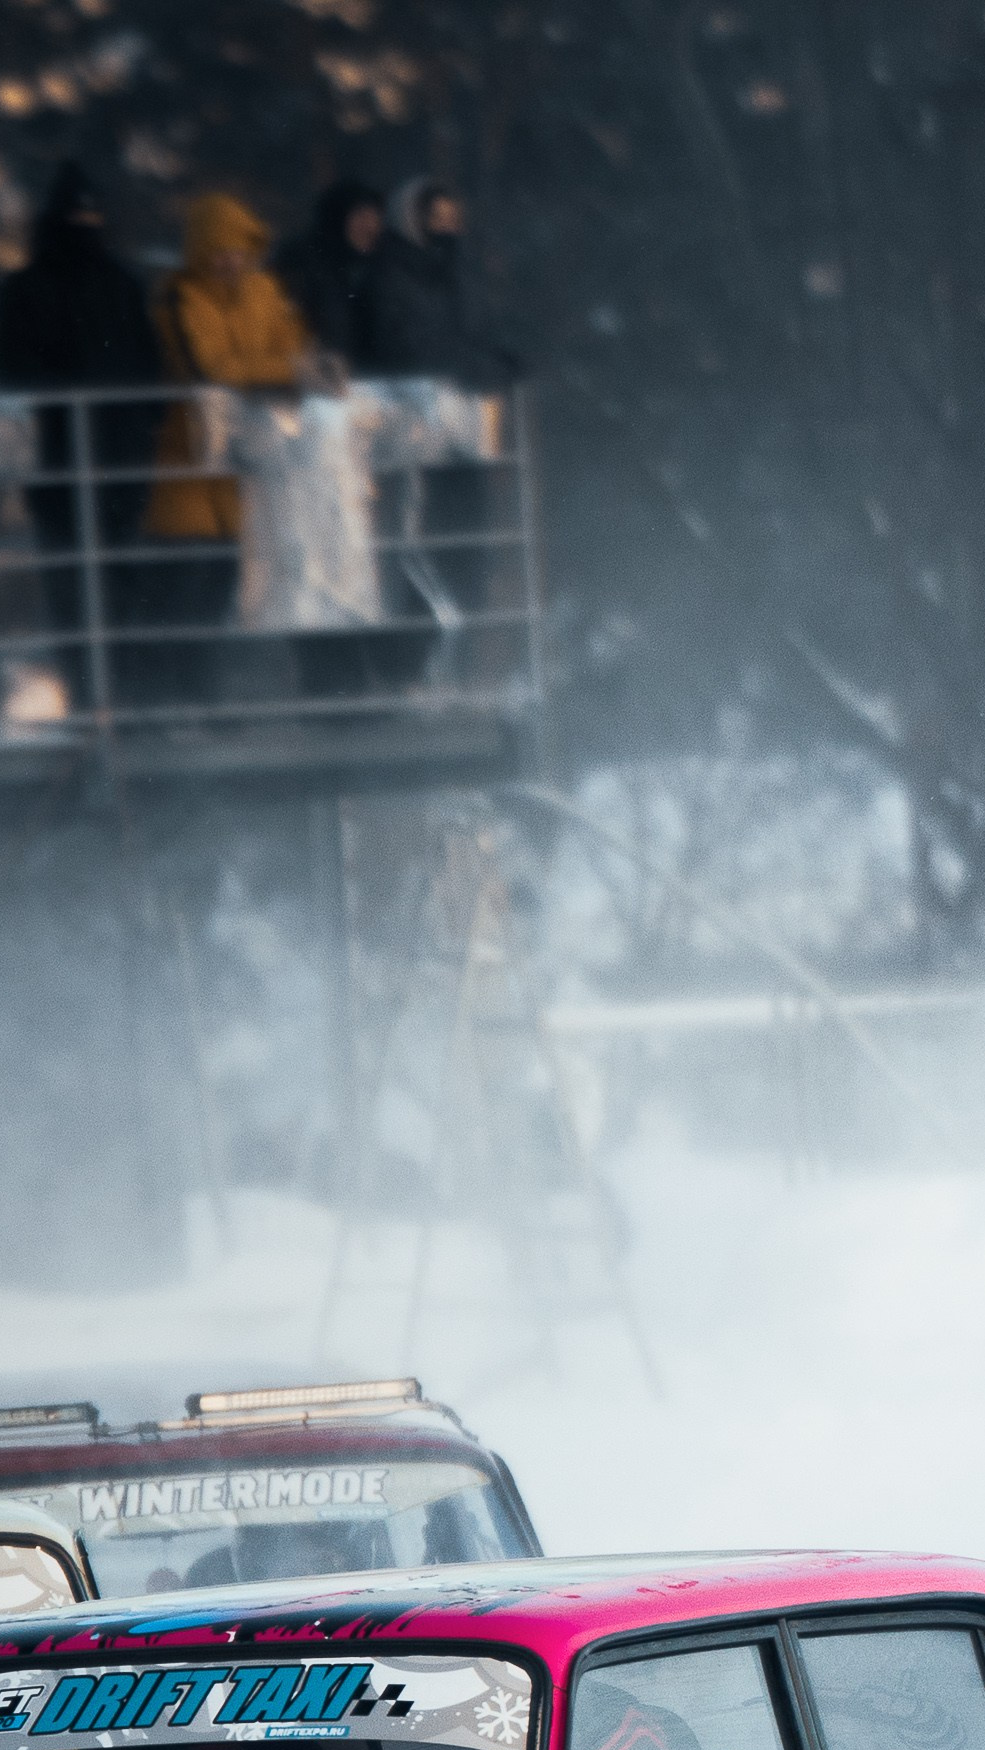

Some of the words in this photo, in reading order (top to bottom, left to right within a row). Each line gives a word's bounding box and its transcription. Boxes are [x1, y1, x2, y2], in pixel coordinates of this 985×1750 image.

[79, 1473, 260, 1523] WINTER
[267, 1468, 390, 1506] MODE
[28, 1667, 232, 1736] DRIFT
[213, 1663, 374, 1725] TAXI
[268, 1726, 347, 1738] DRIFTEXPO.RU
